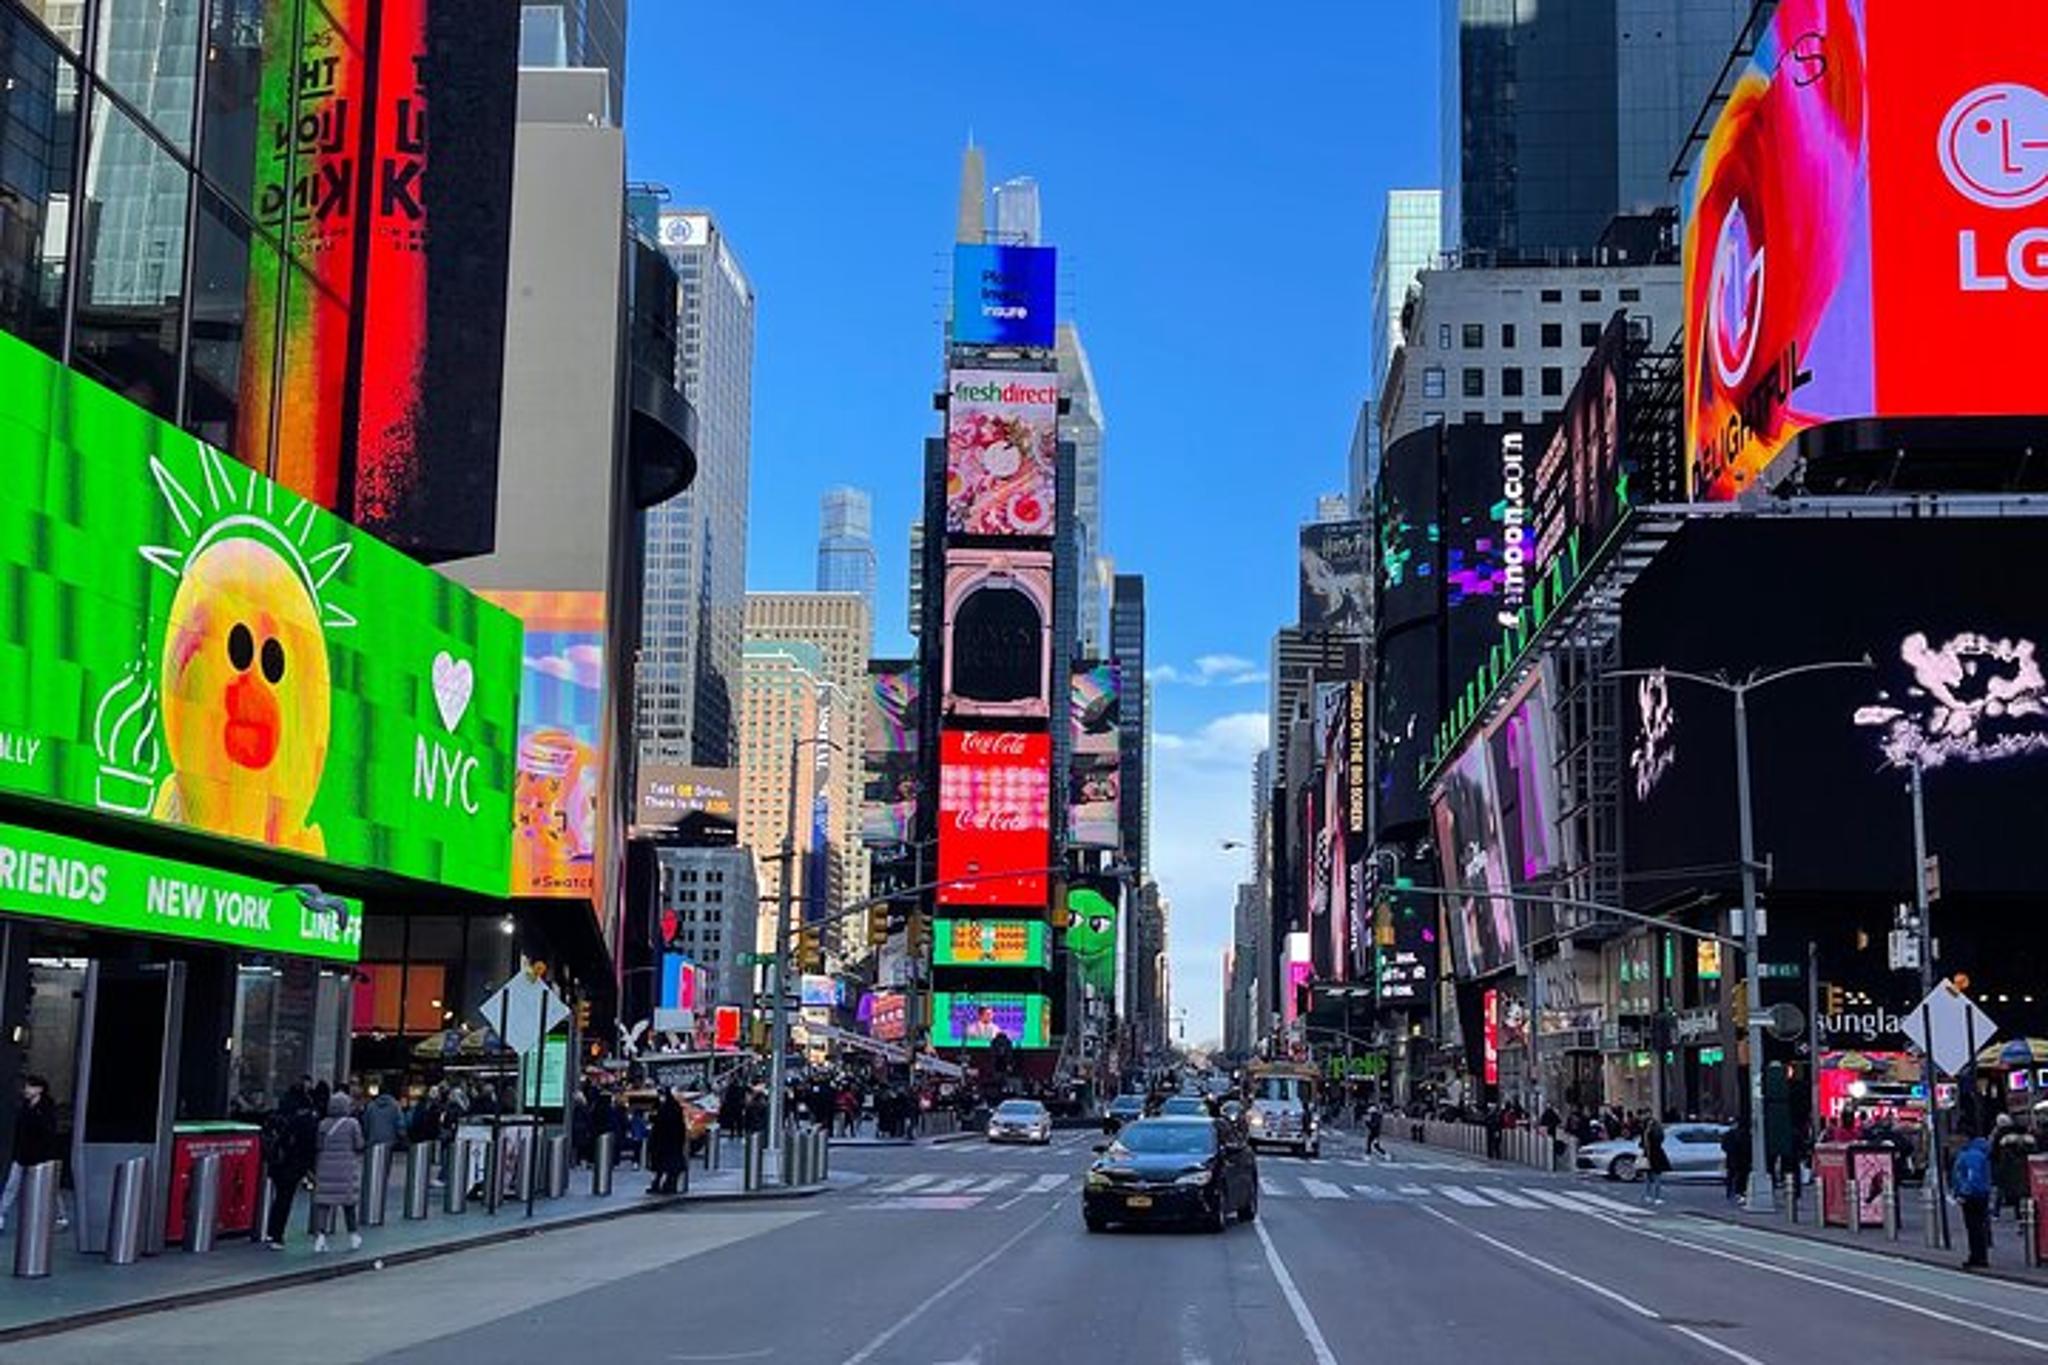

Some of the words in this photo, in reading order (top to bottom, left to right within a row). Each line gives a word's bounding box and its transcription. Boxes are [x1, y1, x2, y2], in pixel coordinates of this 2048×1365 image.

[1958, 227, 2048, 291] LG
[955, 380, 1058, 405] freshdirect
[413, 733, 480, 815] NYC
[147, 875, 207, 920] NEW
[213, 888, 273, 931] YORK
